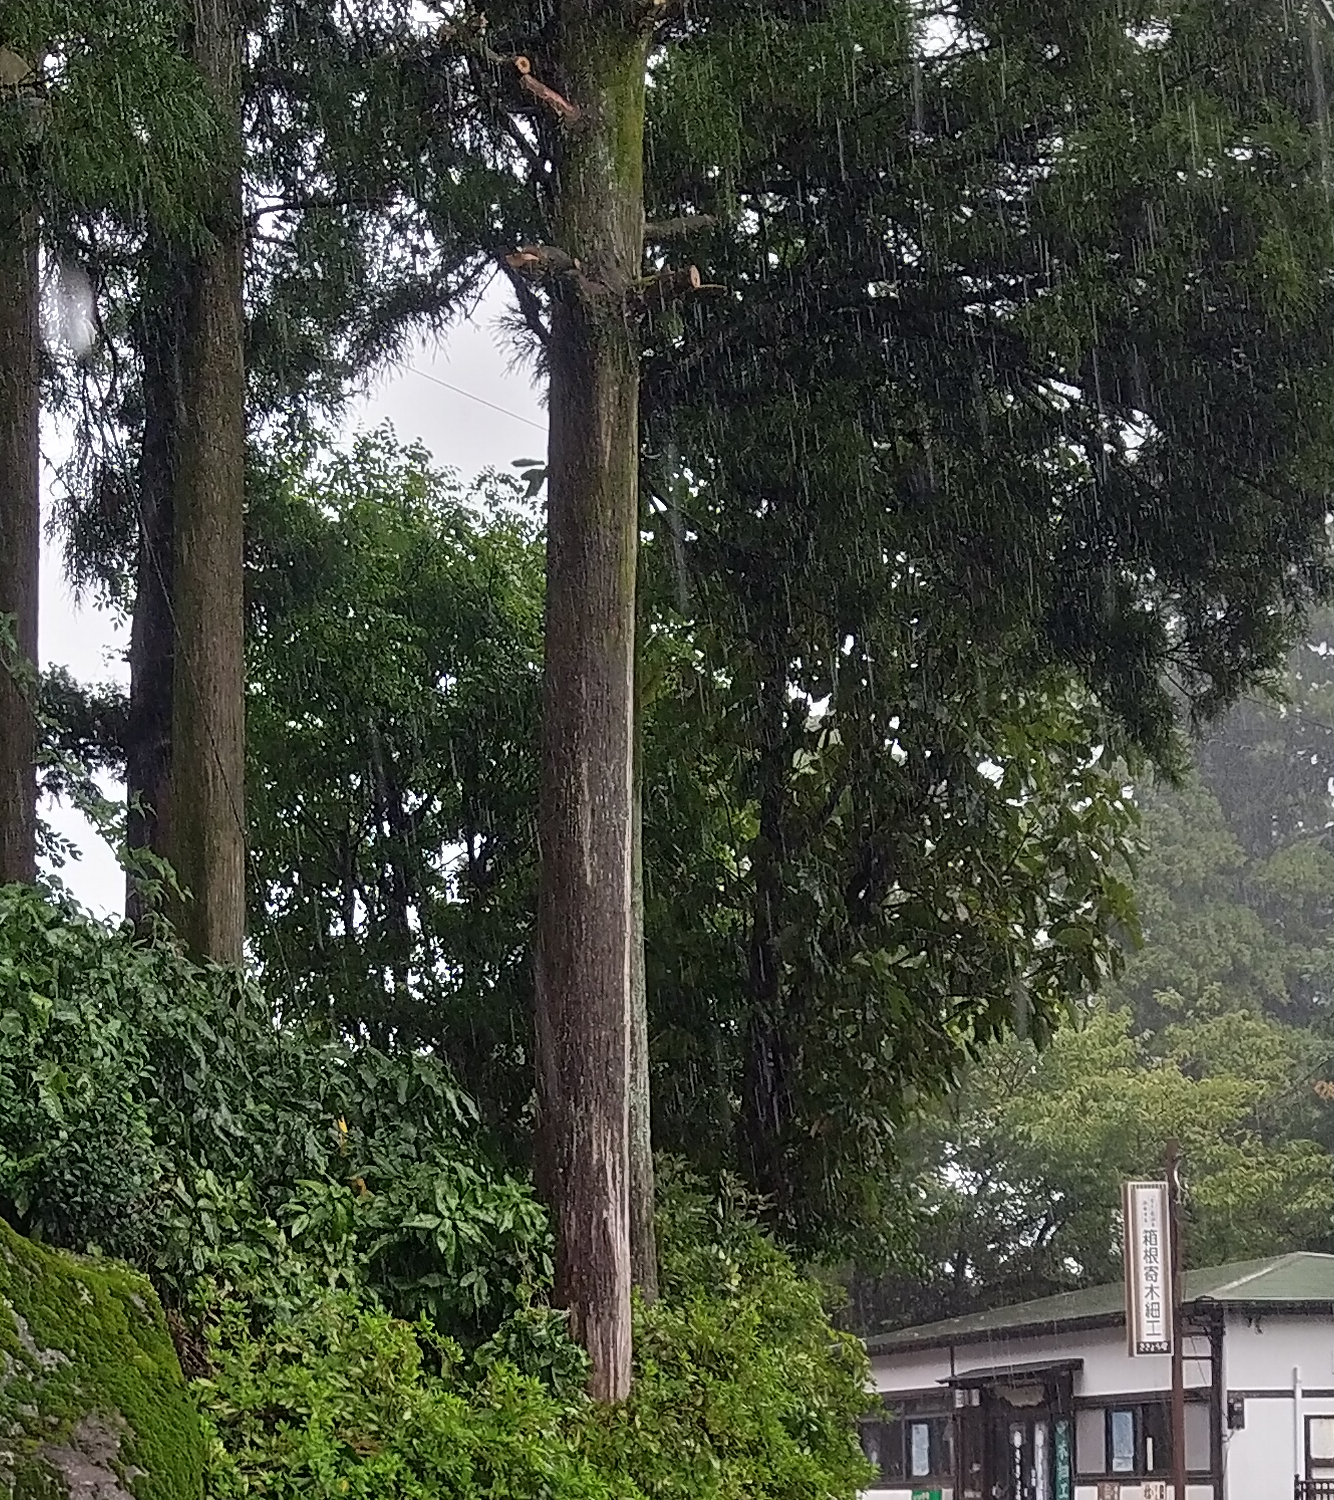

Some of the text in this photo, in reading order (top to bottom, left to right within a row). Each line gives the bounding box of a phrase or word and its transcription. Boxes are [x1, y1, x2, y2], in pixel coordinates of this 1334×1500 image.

[1143, 1229, 1162, 1336] 箱根寄木細工
